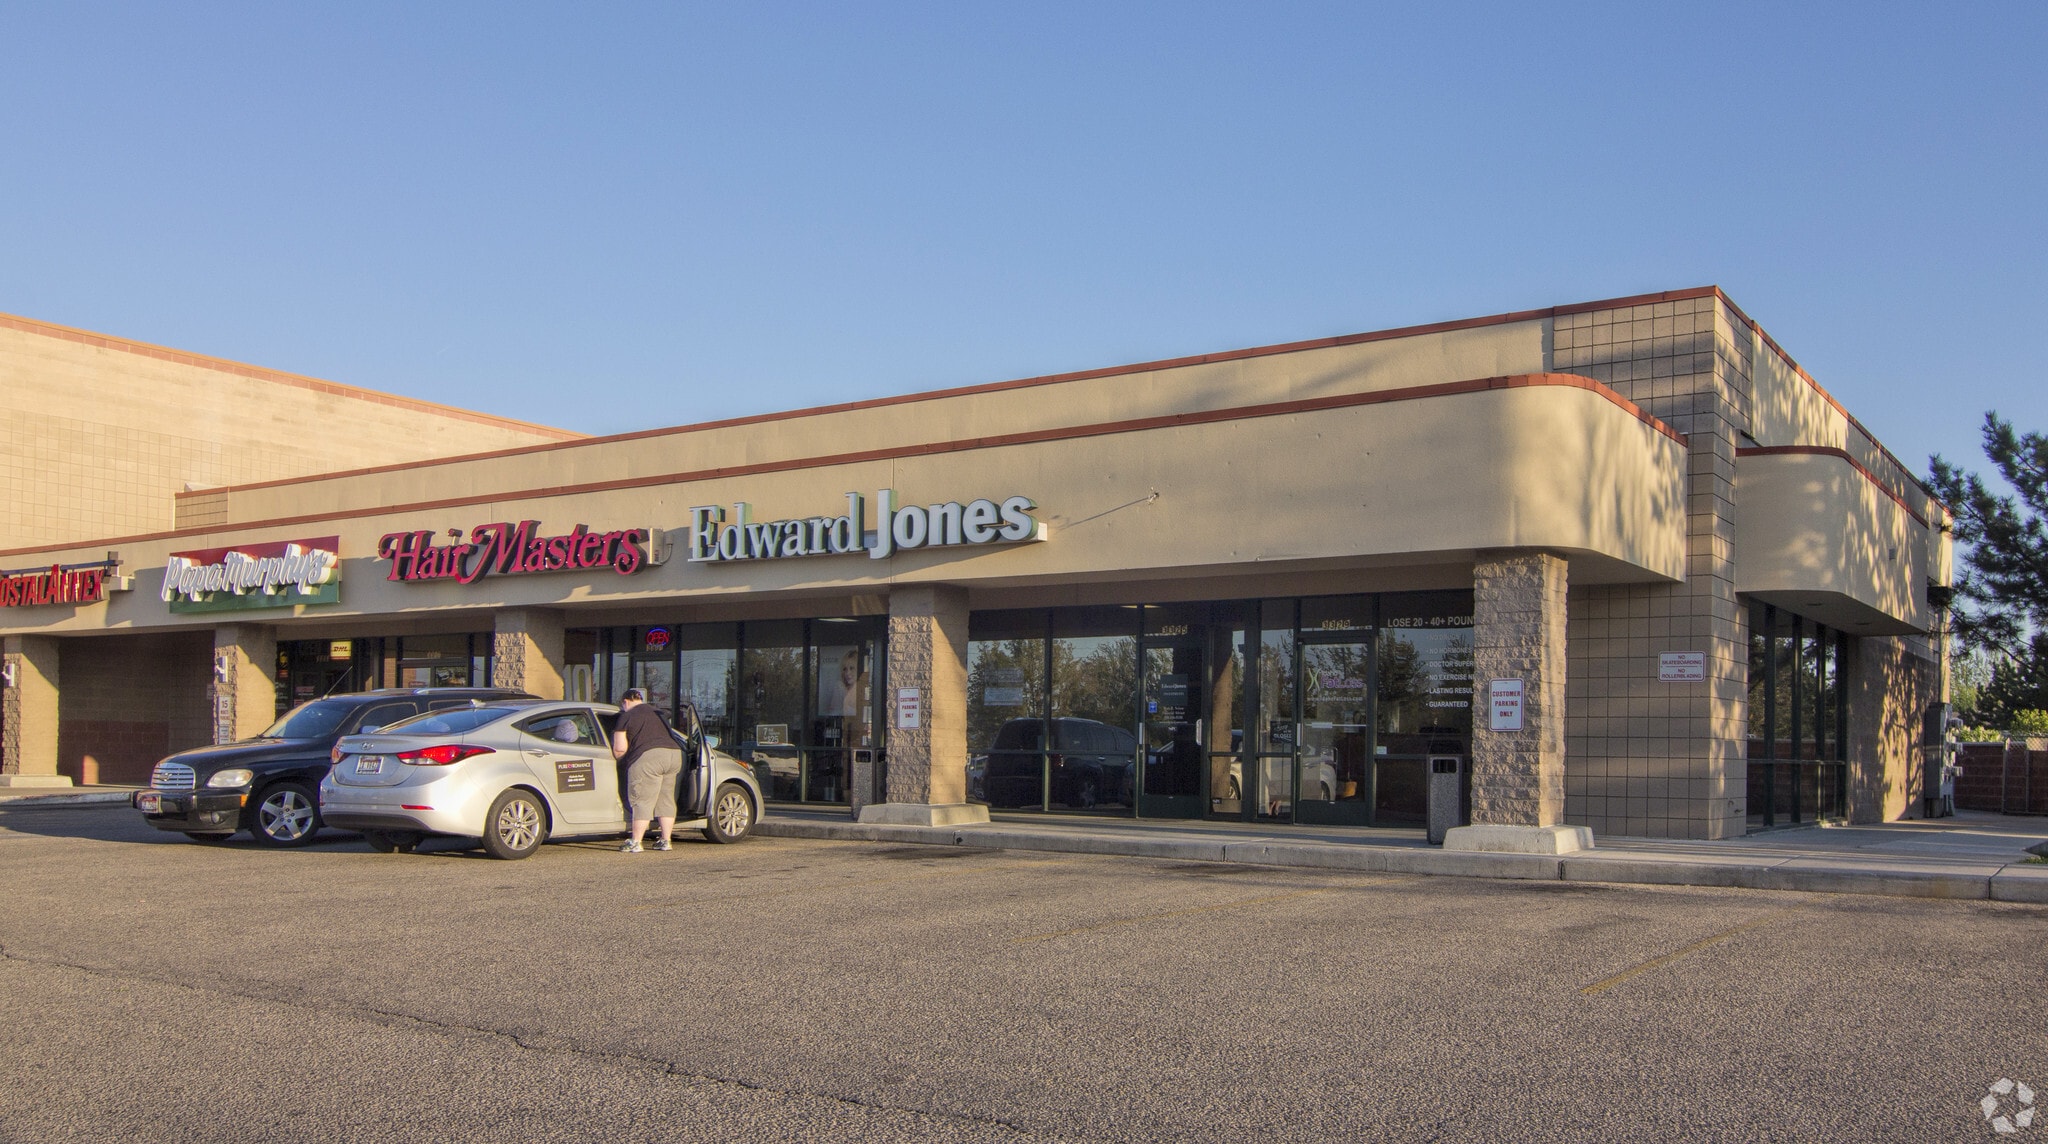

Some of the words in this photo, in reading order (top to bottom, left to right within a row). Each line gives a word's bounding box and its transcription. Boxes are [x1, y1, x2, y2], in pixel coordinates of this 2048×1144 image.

[688, 491, 866, 562] Edward
[870, 489, 1038, 559] Jones
[378, 528, 470, 581] Hair
[456, 519, 646, 585] Masters
[0, 563, 104, 607] OSTALANNEX
[161, 556, 223, 602] Papa
[645, 631, 670, 645] OPEN
[1321, 620, 1350, 629] 3329
[1387, 618, 1411, 628] LOSE
[1413, 617, 1423, 627] 20
[1430, 616, 1446, 626] 40+
[1447, 615, 1475, 626] POUN
